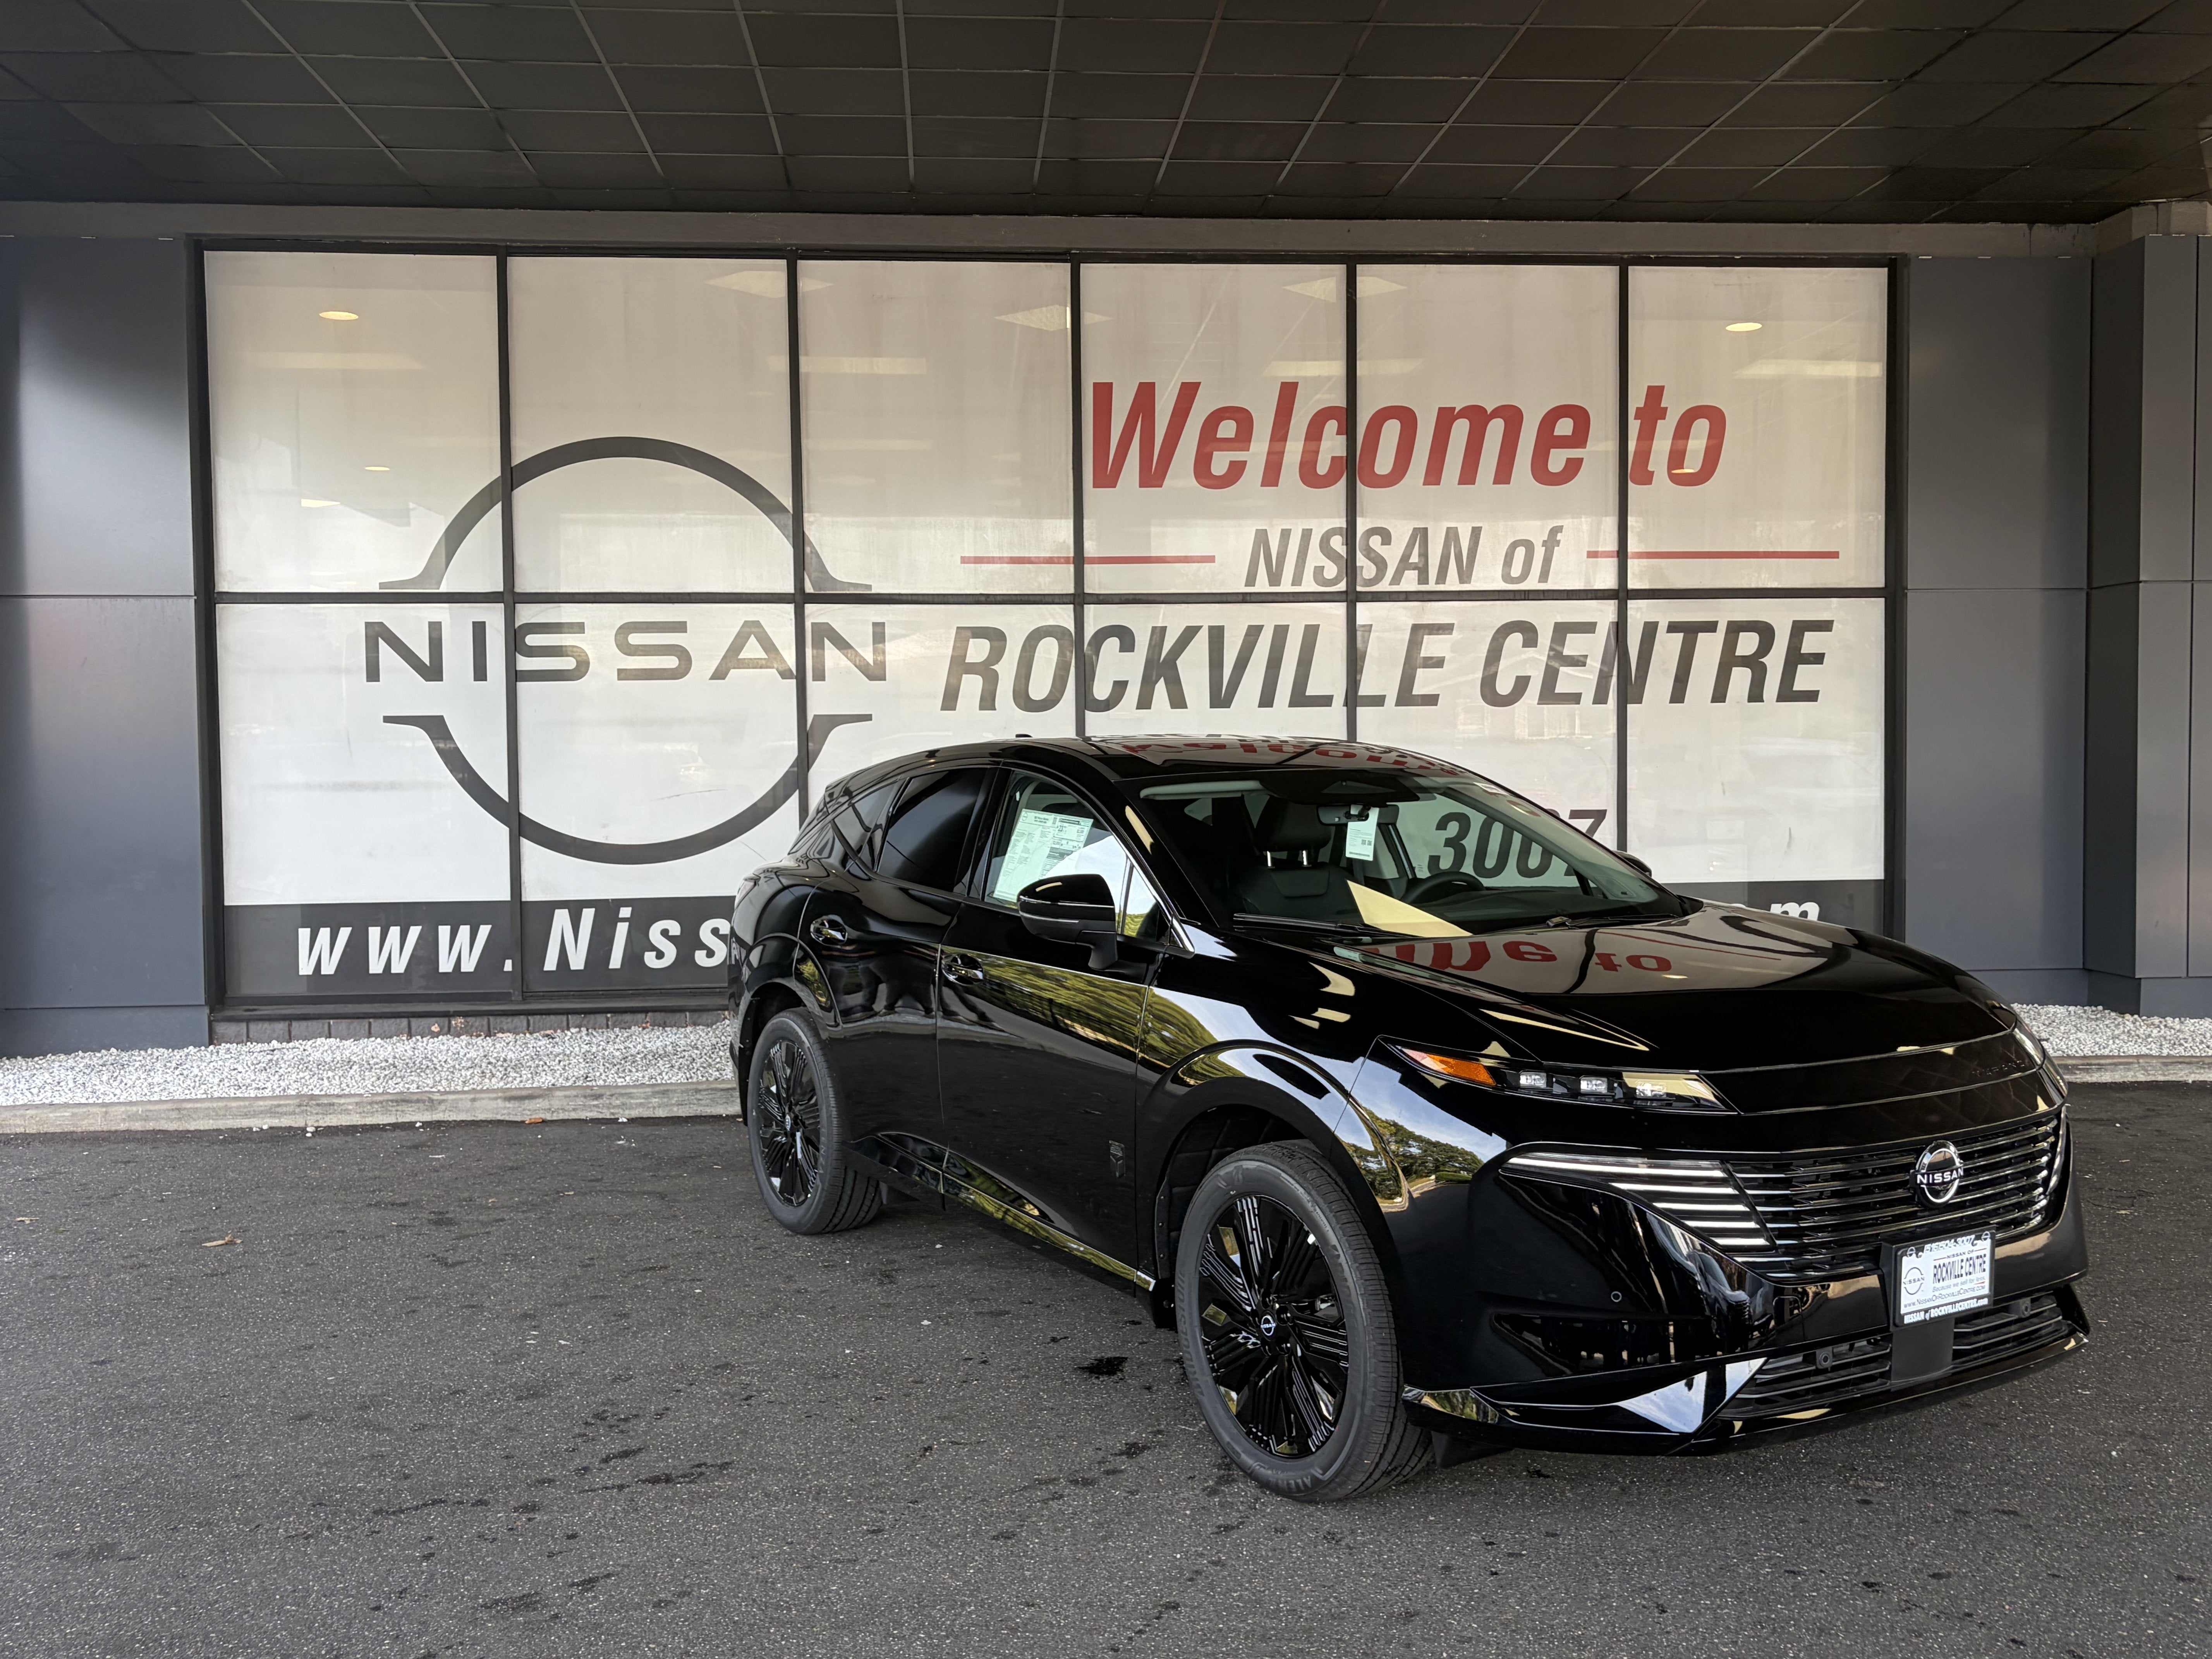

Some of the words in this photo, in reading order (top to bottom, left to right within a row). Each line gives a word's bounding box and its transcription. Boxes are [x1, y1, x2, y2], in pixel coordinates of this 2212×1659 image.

[1091, 381, 1591, 489] Welcome
[1628, 385, 1728, 488] to
[1244, 526, 1483, 587] NISSAN
[1502, 525, 1563, 584] of
[364, 620, 887, 683] NISSAN
[941, 622, 1455, 712] ROCKVILLE
[1480, 619, 1834, 707] CENTRE
[298, 906, 730, 975] www.Niss
[1917, 1166, 1964, 1184] NISSAN
[1903, 1277, 1925, 1285] NISSAN
[1932, 1284, 1952, 1292] Because
[1933, 1259, 1964, 1284] ROCKVILLE
[1965, 1254, 1987, 1277] CENTRE
[1904, 1311, 1925, 1324] NISSAN
